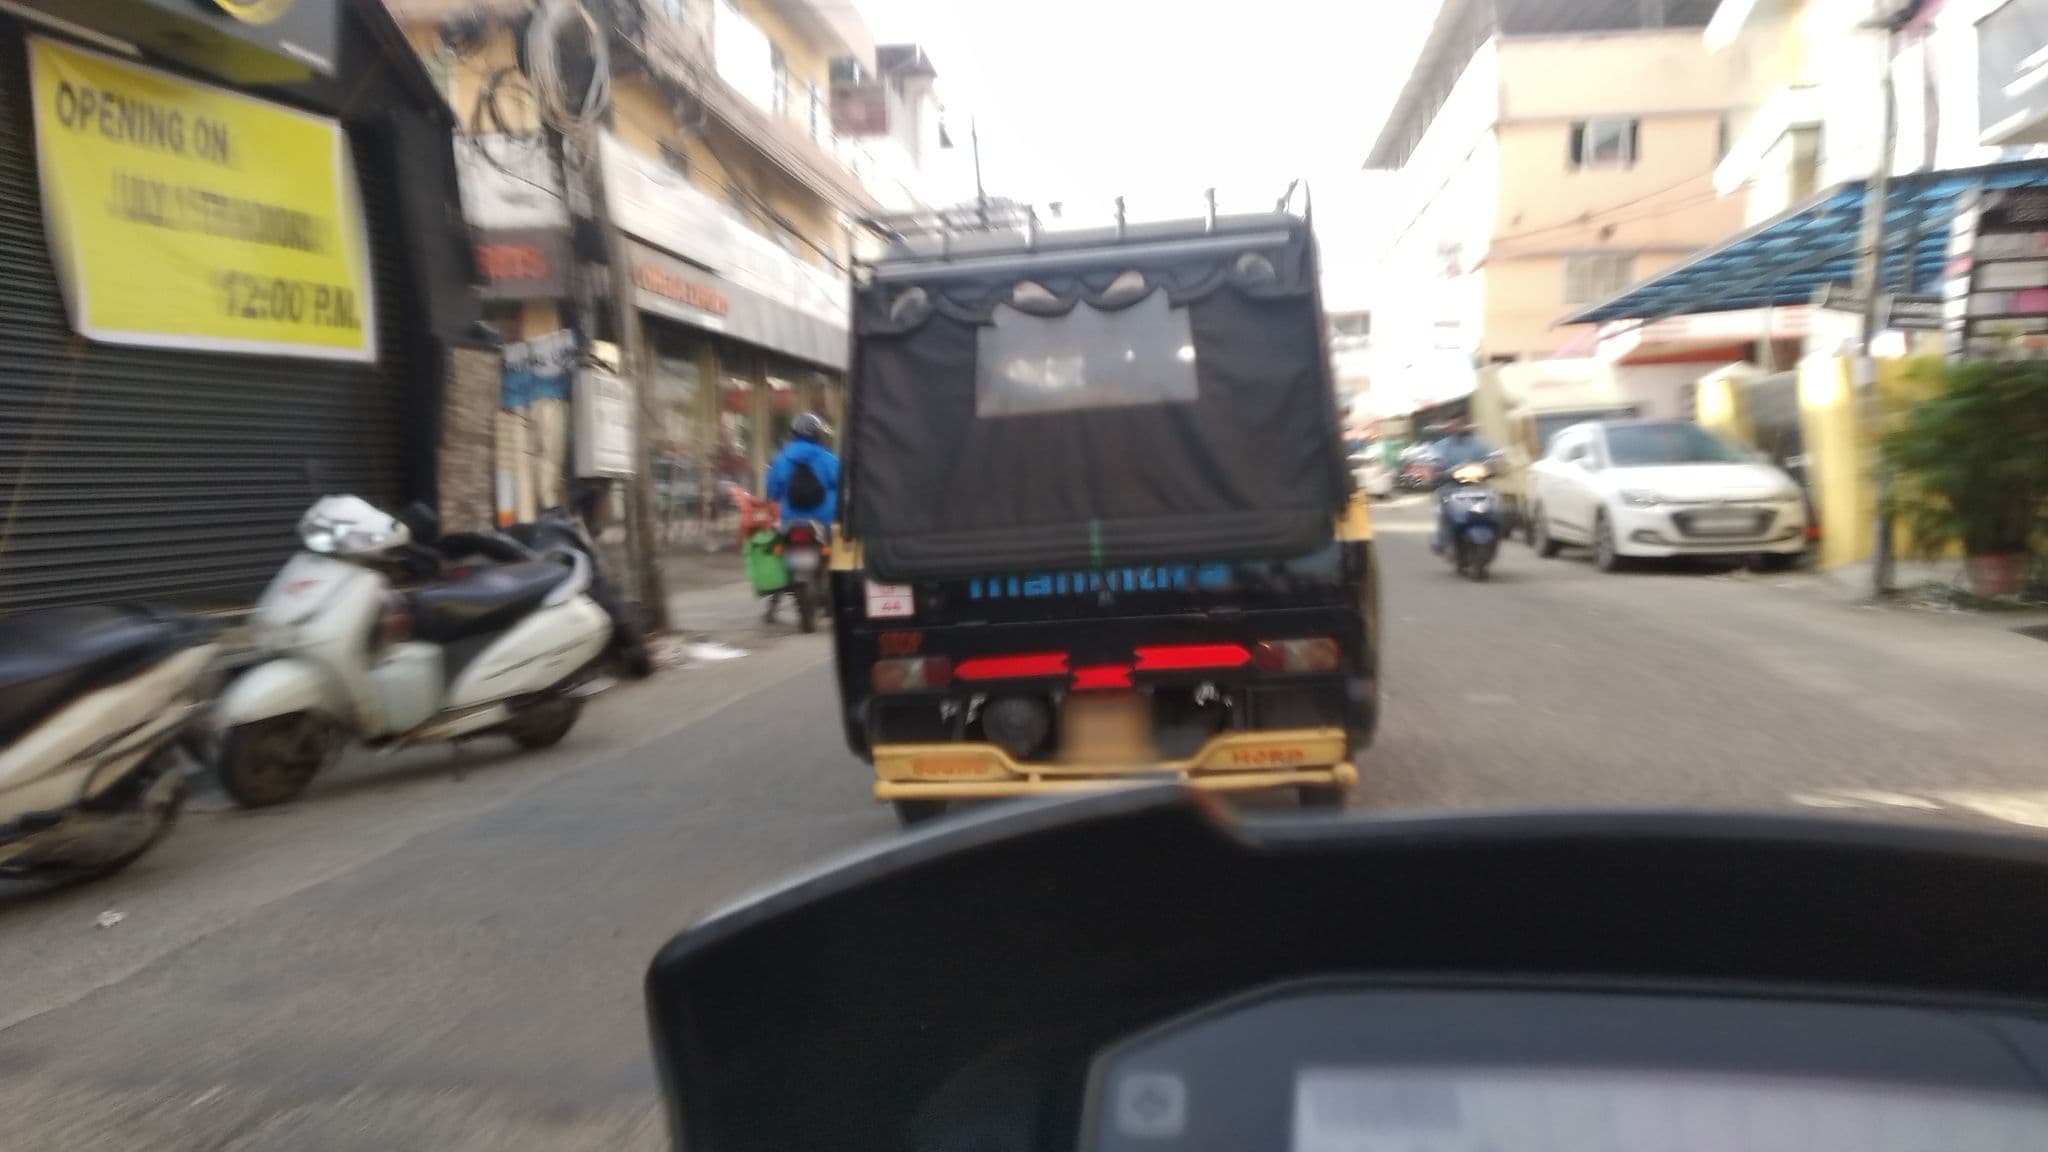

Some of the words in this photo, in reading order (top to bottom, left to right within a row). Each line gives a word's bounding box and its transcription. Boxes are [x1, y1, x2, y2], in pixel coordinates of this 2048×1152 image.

[56, 79, 185, 153] OPENING
[194, 114, 229, 163] ON
[222, 268, 304, 324] 12:00
